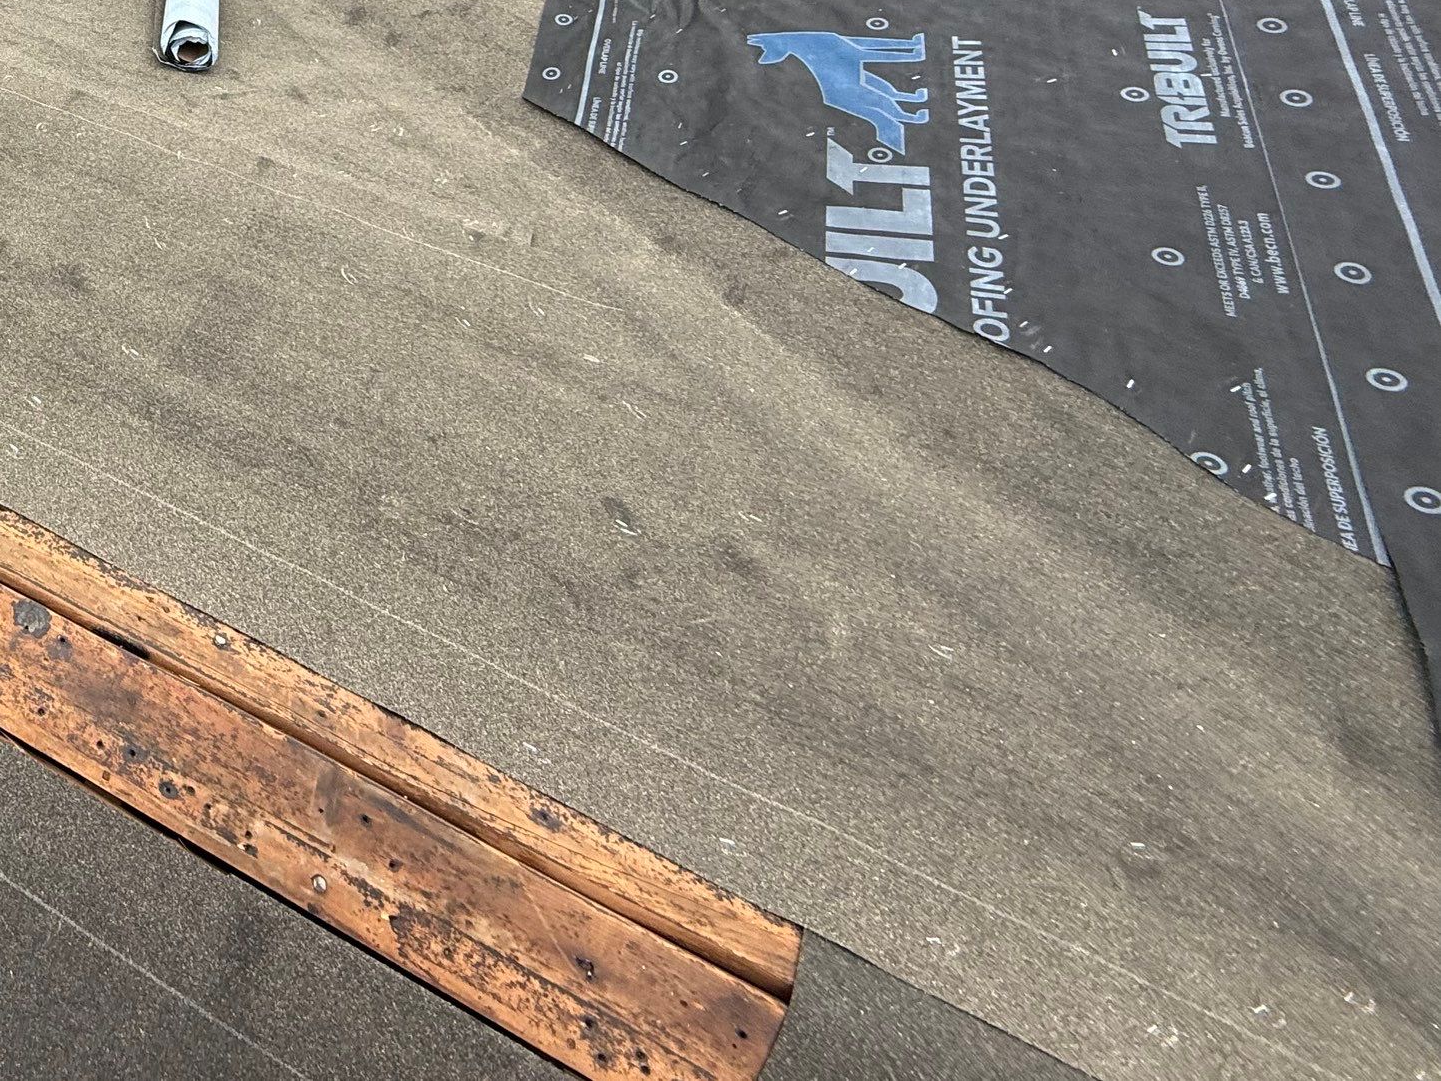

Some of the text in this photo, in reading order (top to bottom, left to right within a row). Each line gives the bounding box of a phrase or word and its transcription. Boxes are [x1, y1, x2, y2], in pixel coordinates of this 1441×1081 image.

[1137, 8, 1219, 149] TRIBUILT
[951, 35, 1001, 239] UNDERLAYMENT
[1197, 192, 1211, 208] TYPE
[1202, 209, 1215, 226] D226
[1206, 227, 1220, 247] ASTM
[1222, 226, 1236, 246] ASTM
[1211, 249, 1227, 278] EXCEEDS
[1244, 244, 1261, 275] CAN/CSA
[1258, 214, 1288, 293] www.becn.com
[1229, 257, 1244, 275] TYPE
[1218, 280, 1231, 290] OR
[1221, 291, 1236, 317] MEETS
[1250, 419, 1262, 431] and
[1270, 448, 1282, 457] de
[1289, 458, 1302, 480] techo
[1313, 428, 1346, 511] SUPERPOSICIÓN
[1275, 460, 1293, 506] condiciones
[1293, 482, 1306, 494] del
[1335, 514, 1352, 530] DE
